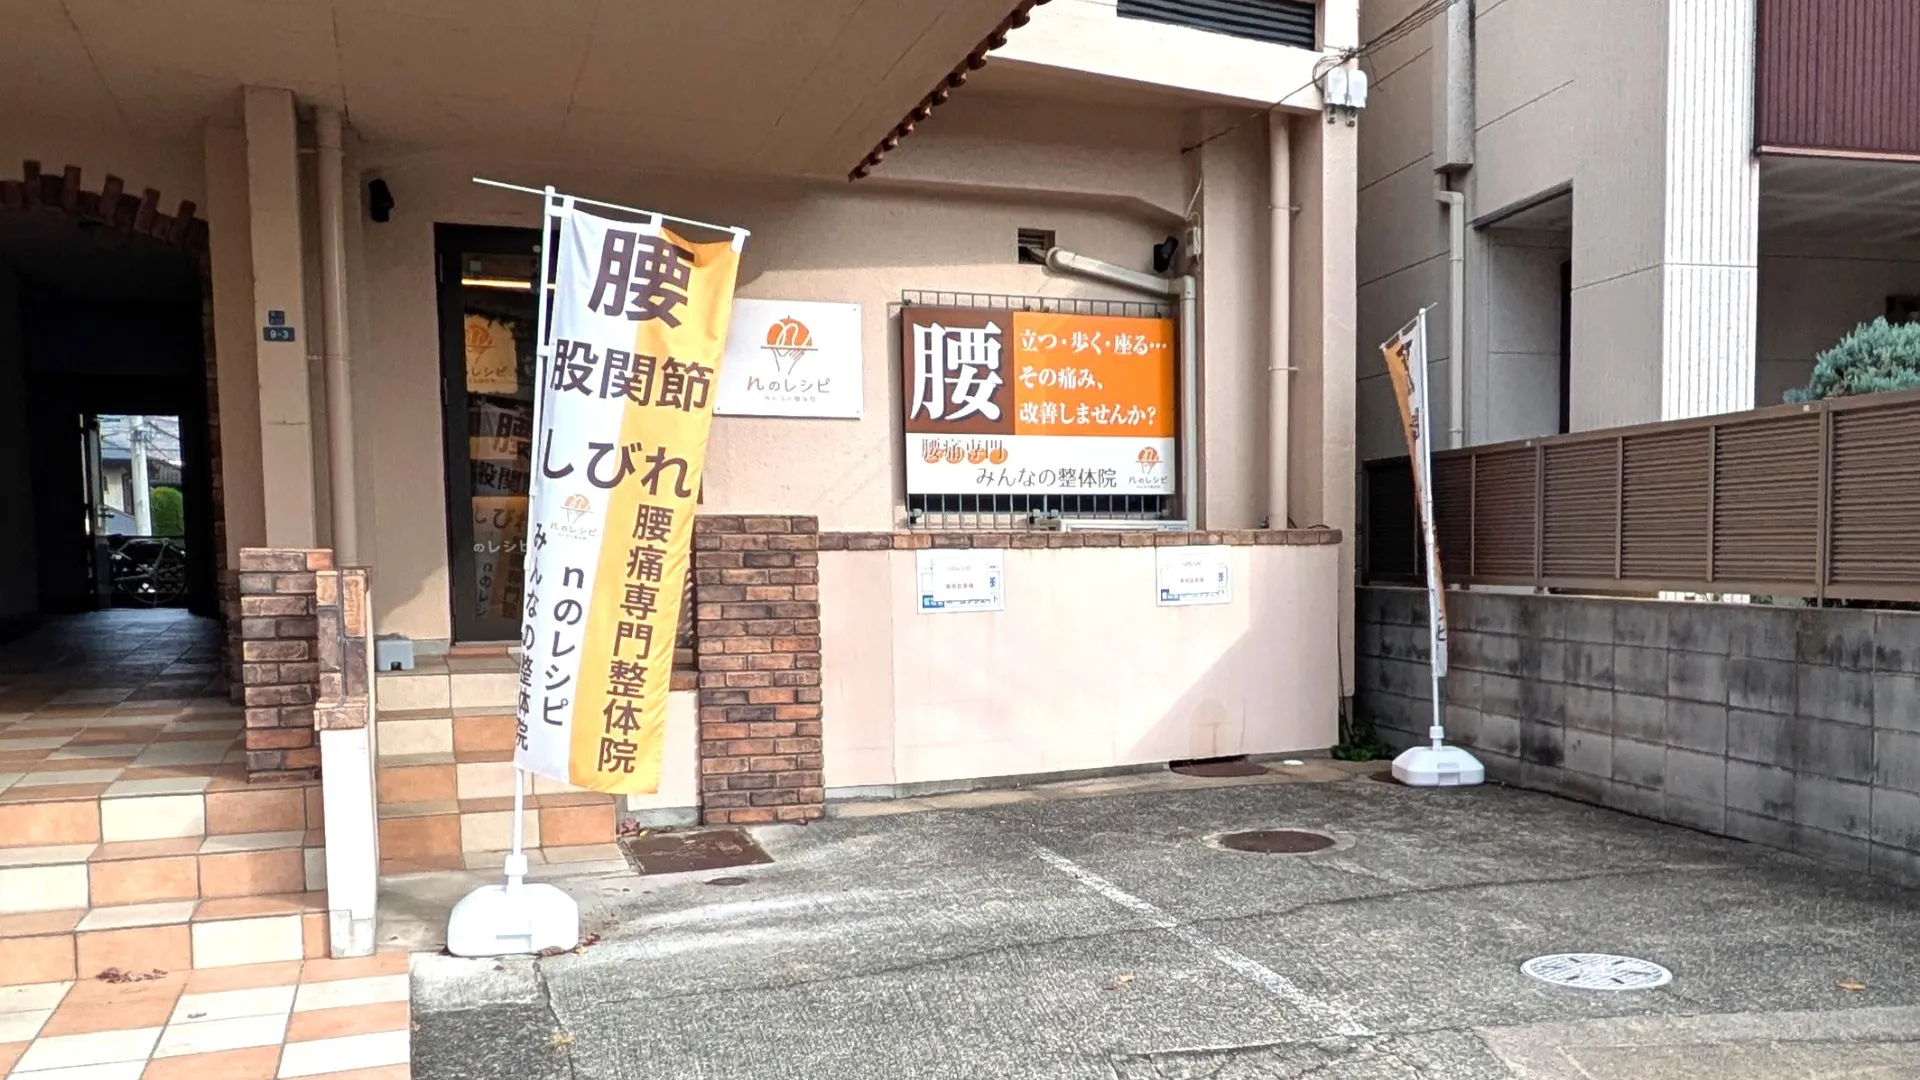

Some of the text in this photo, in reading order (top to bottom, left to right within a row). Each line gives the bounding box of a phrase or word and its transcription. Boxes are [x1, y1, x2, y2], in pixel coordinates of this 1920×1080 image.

[588, 228, 695, 329] 腰
[550, 339, 714, 412] 股関節
[910, 321, 1004, 421] 腰
[1019, 366, 1104, 390] その痛み、
[542, 428, 691, 498] しびれ
[921, 438, 1004, 460] 腰痛専門
[976, 467, 1117, 488] みんなの整体院
[543, 566, 585, 726] nのレシピ
[597, 503, 674, 774] 腰痛専門整体院
